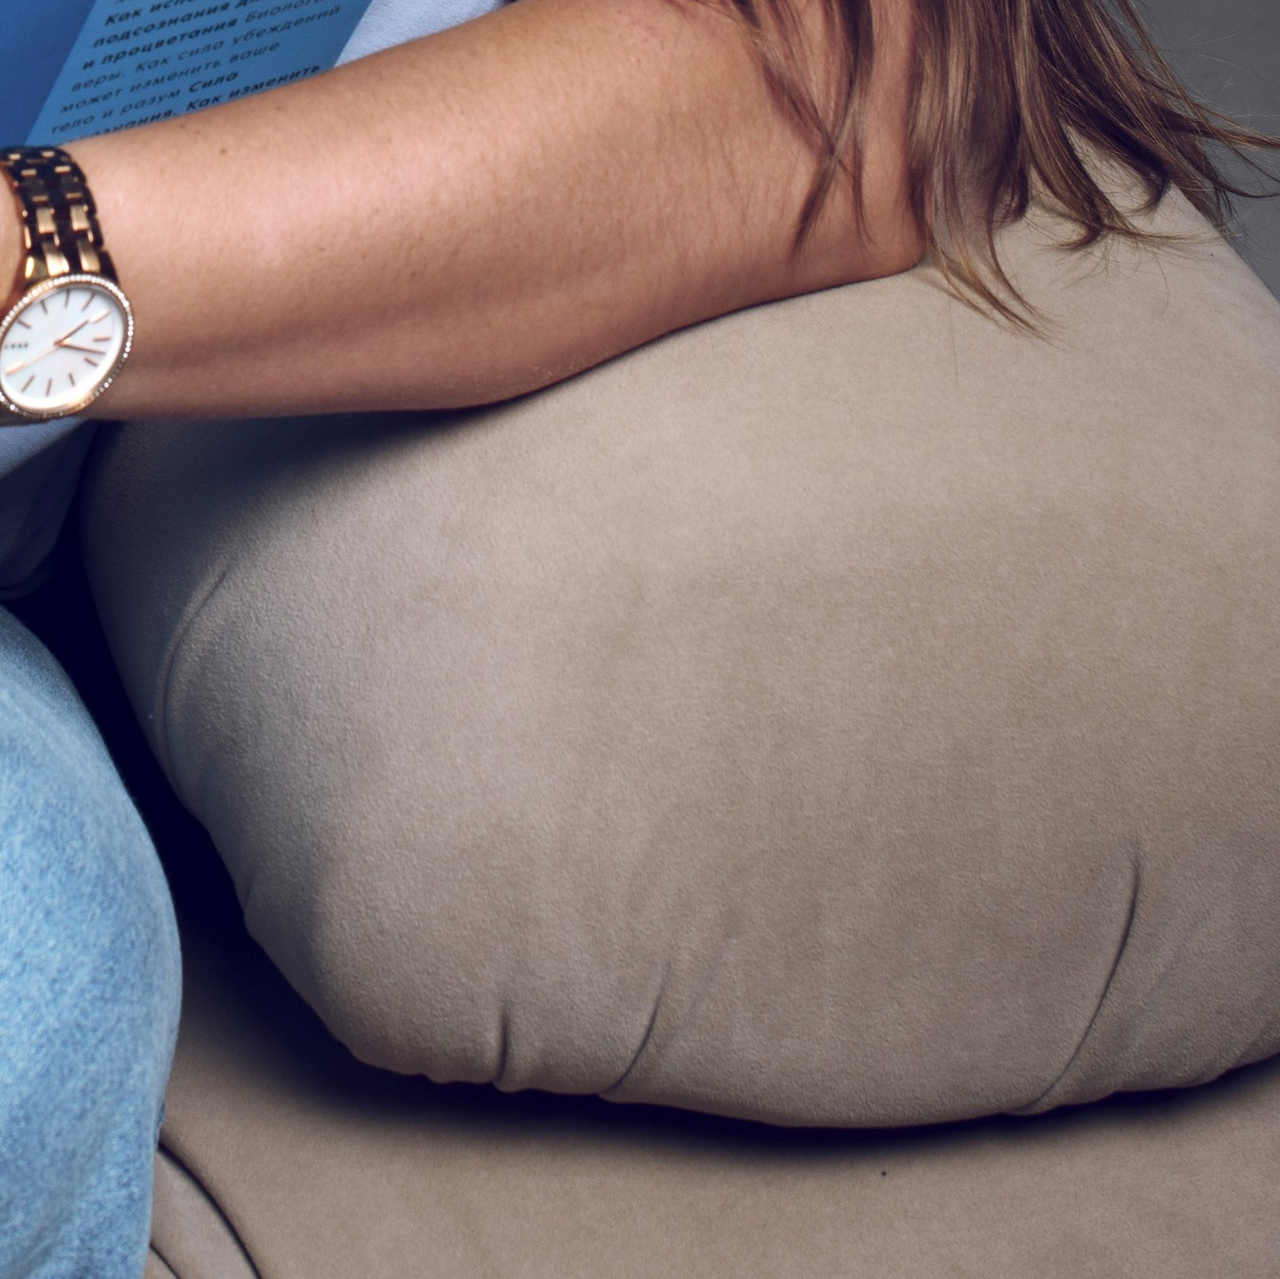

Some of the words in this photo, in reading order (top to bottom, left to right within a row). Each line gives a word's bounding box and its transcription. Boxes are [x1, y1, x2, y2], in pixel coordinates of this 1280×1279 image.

[92, 1, 230, 48] подсознания
[103, 7, 143, 26] Как
[100, 17, 238, 65] процветания
[187, 70, 239, 93] Сила
